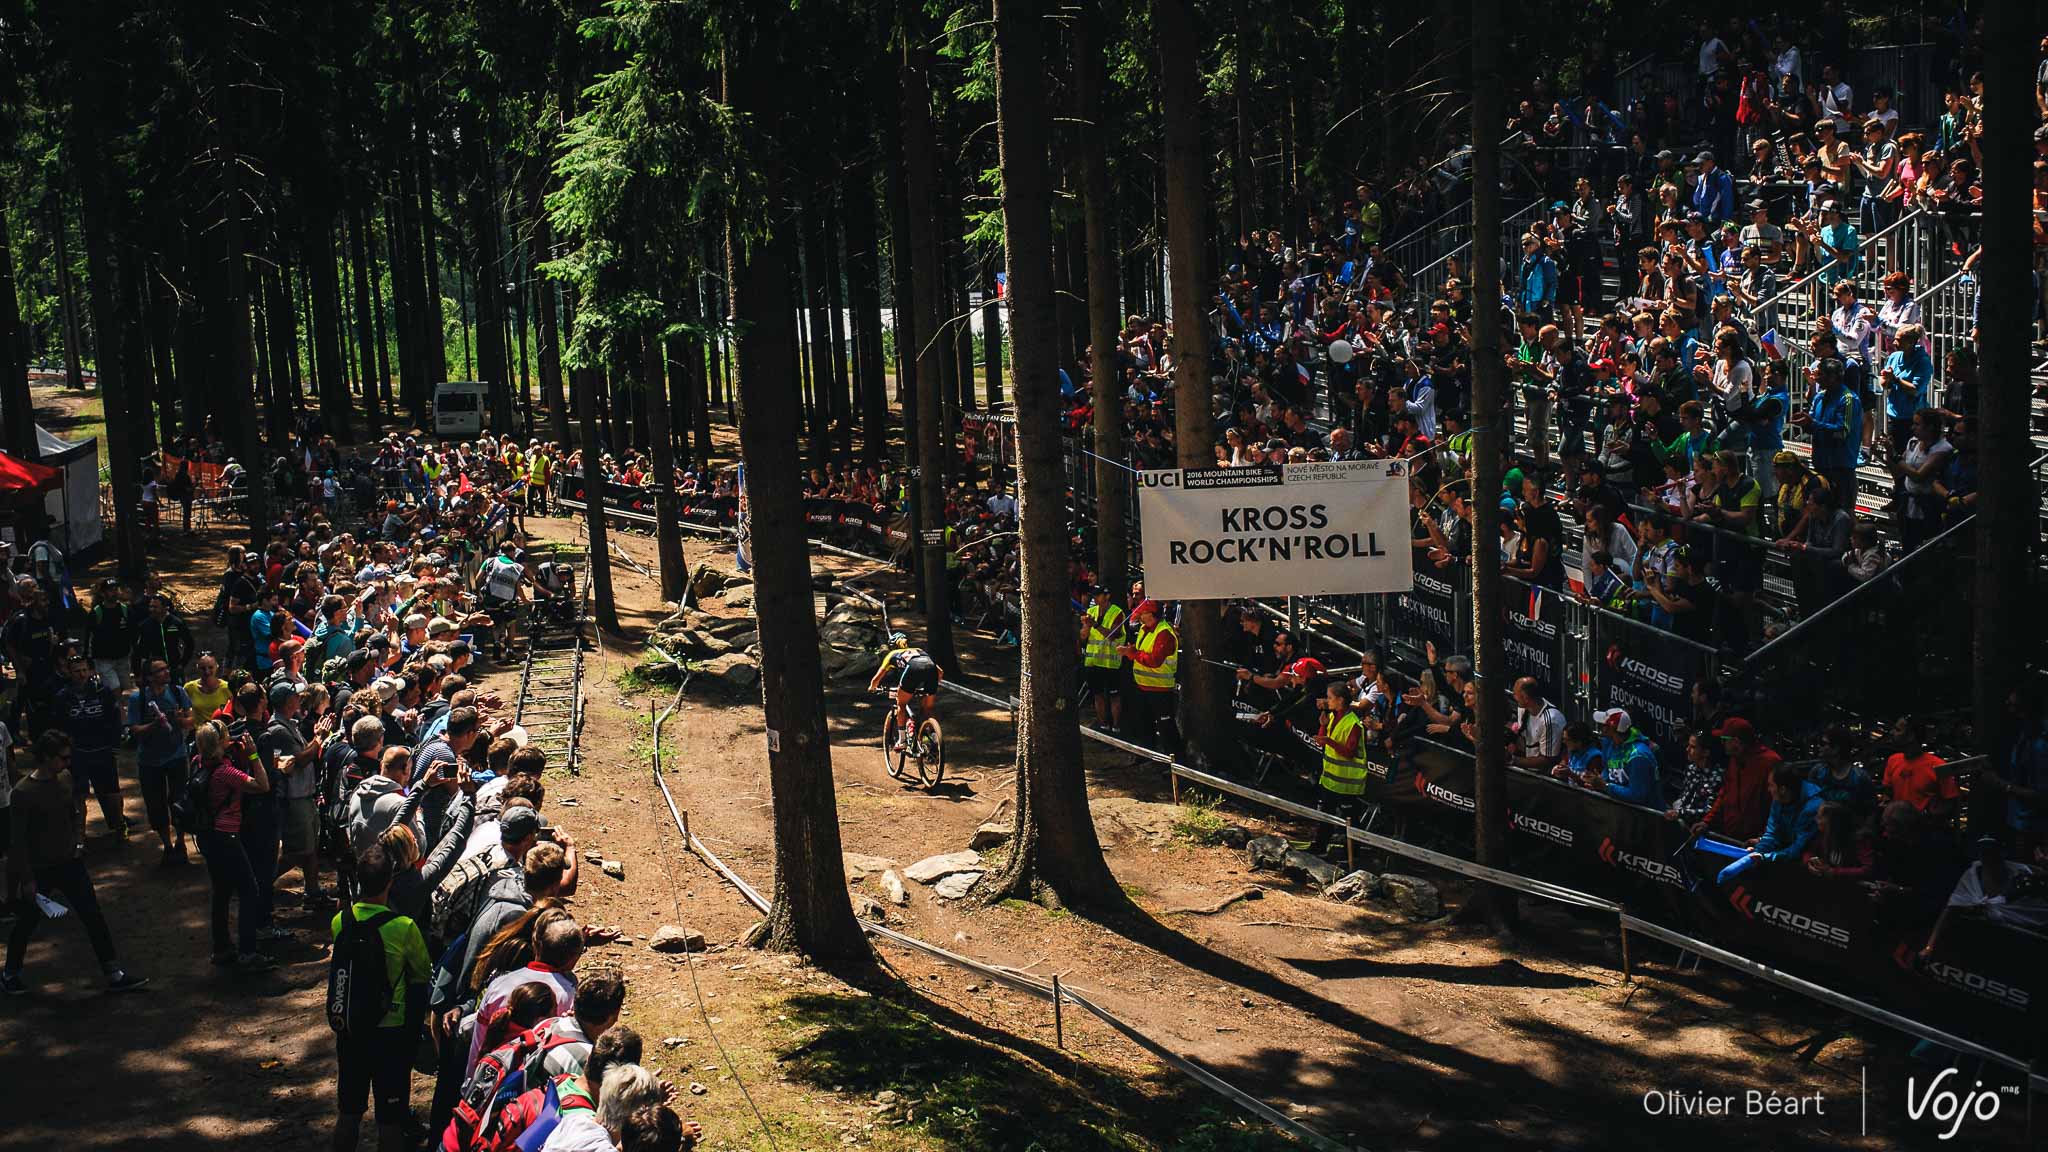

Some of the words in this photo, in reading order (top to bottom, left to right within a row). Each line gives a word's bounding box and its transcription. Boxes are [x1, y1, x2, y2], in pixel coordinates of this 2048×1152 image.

[1143, 471, 1180, 487] UCI
[1186, 471, 1202, 479] 2016
[1203, 469, 1244, 478] MOUNTAIN
[1245, 468, 1262, 476] BIKE
[1187, 479, 1215, 487] WORLD
[1215, 476, 1278, 486] CHAMPIONSHIPS
[1287, 474, 1312, 482] CZECH
[1313, 473, 1347, 481] REPUBLIC
[1336, 463, 1346, 471] NA
[1221, 504, 1328, 533] KROSS
[1169, 532, 1386, 565] ROCK'N'ROLL
[1620, 656, 1685, 690] KROSS
[1610, 684, 1675, 725] ROCK'N'ROLL
[1426, 782, 1476, 809] KROSS
[1514, 812, 1574, 842] KROSS
[1754, 901, 1851, 943] KROSS
[331, 968, 348, 1014] Sweep
[1922, 960, 2030, 1005] KROSS
